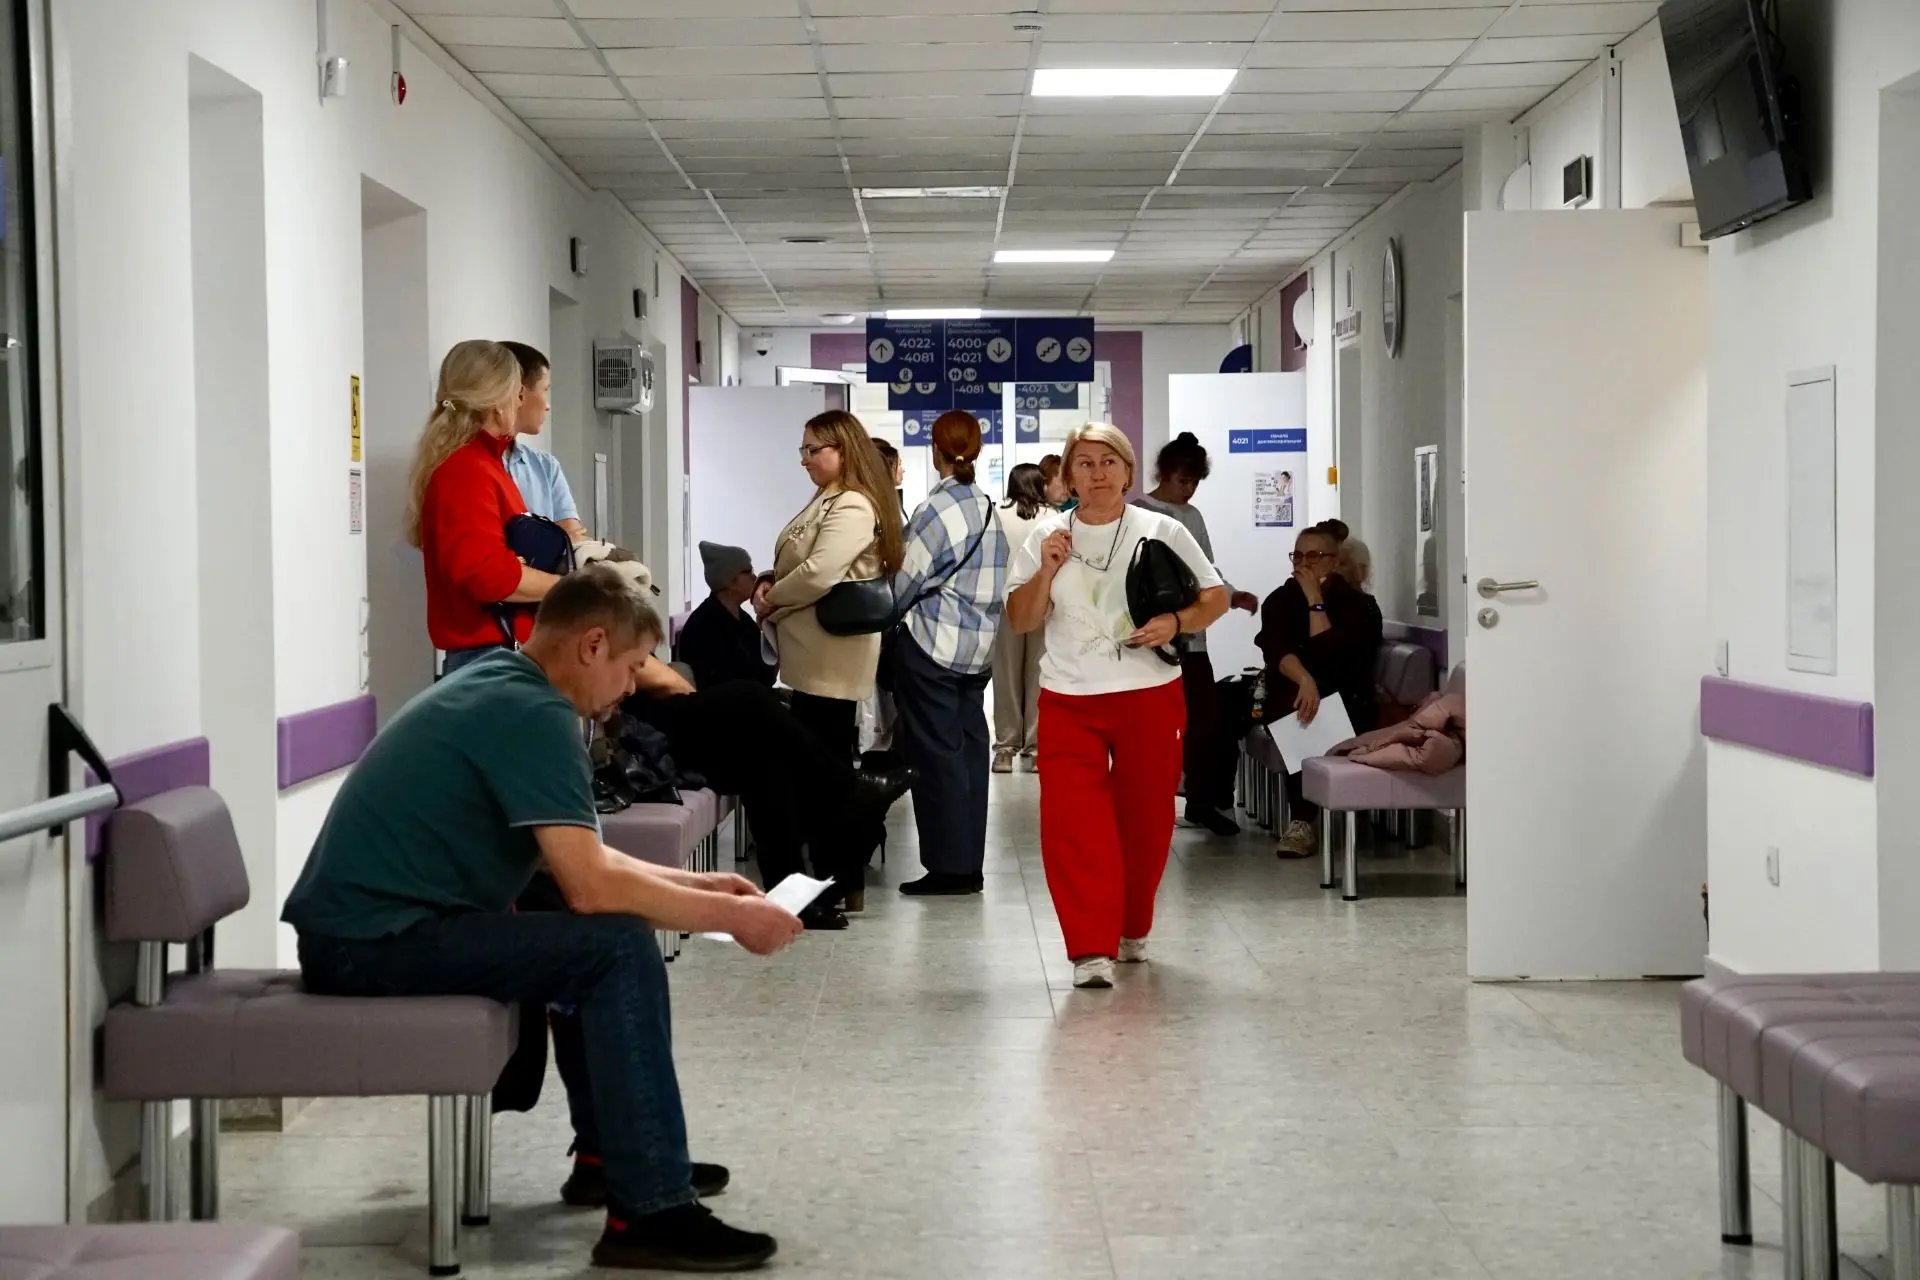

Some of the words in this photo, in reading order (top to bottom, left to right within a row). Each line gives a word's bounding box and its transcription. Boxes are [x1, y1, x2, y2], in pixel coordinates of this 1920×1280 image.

[899, 338, 936, 350] 4022-
[947, 338, 987, 350] 4000-
[899, 352, 935, 363] -4081
[948, 352, 982, 363] -4021
[955, 384, 984, 394] -4081
[1017, 384, 1049, 394] -4023
[1232, 437, 1249, 445] 4021
